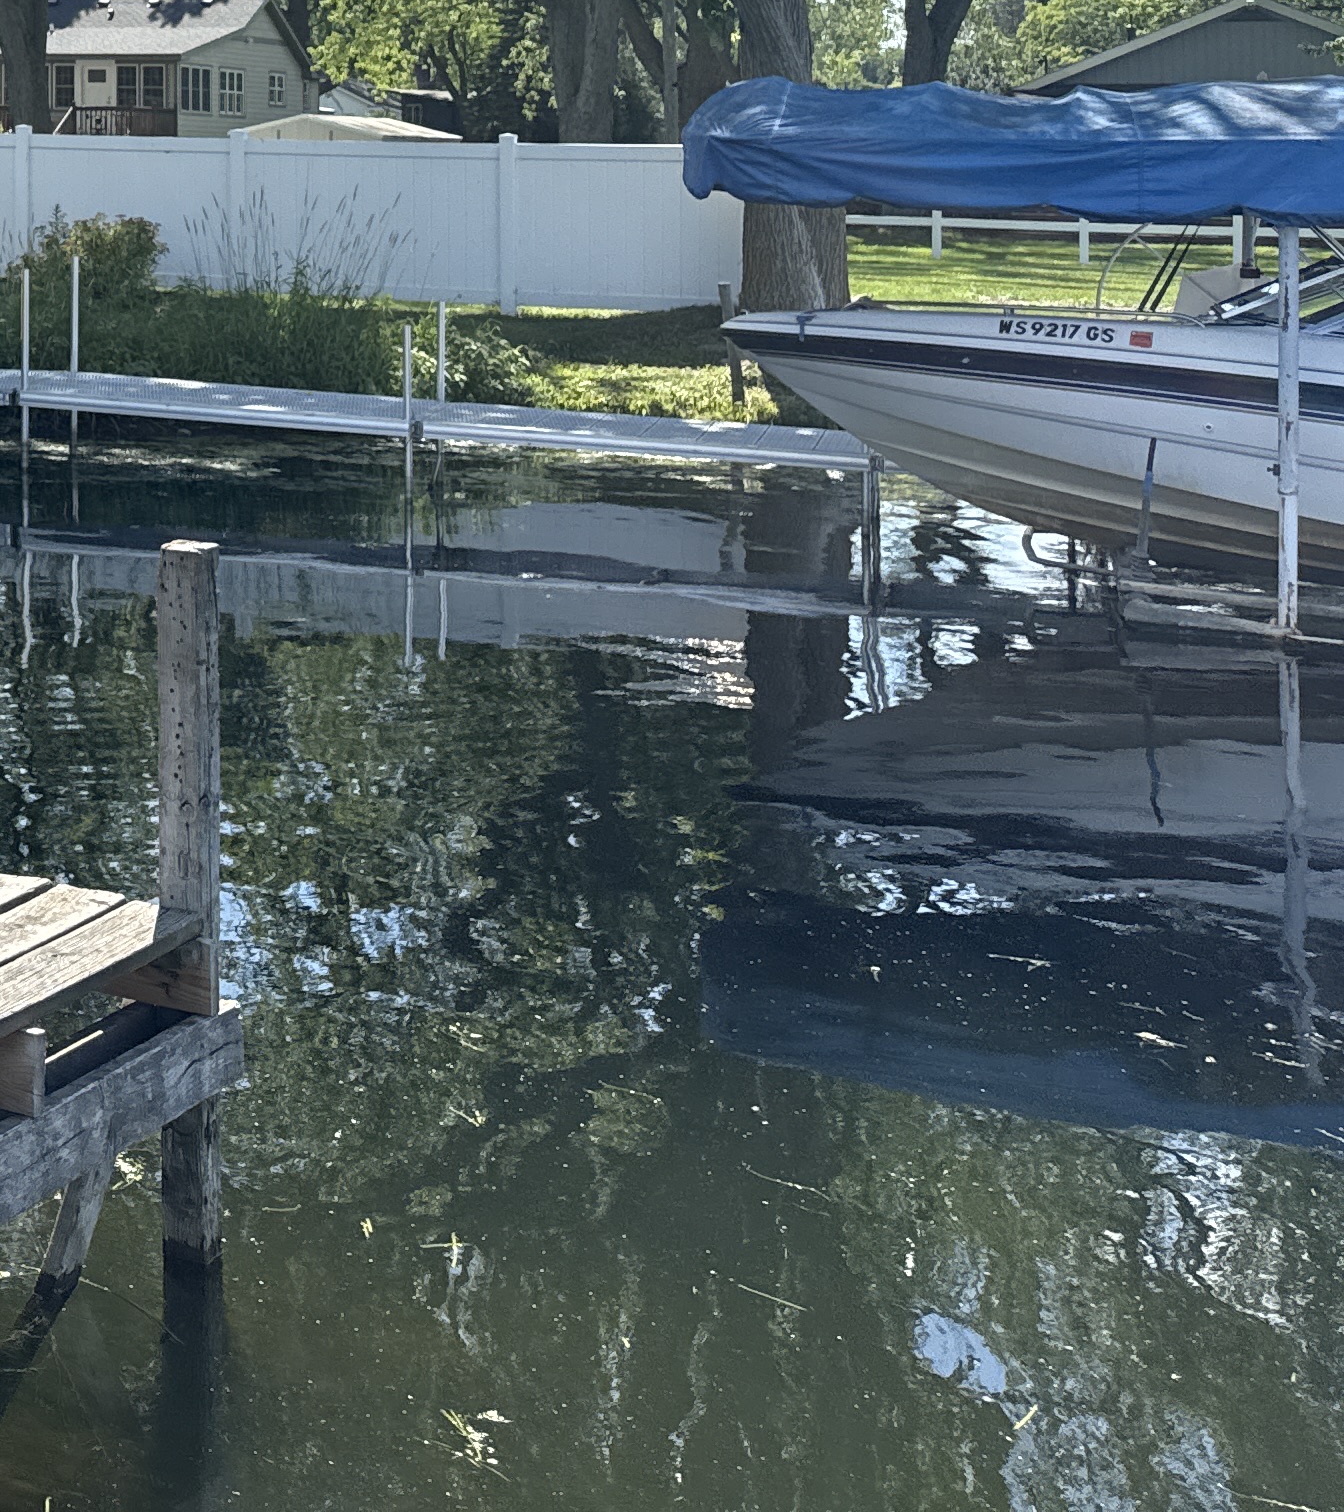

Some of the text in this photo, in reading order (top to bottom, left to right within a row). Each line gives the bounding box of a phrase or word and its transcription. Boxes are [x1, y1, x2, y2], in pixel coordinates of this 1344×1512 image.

[999, 319, 1028, 335] WS
[1031, 321, 1082, 339] 9217
[1085, 326, 1115, 343] GS
